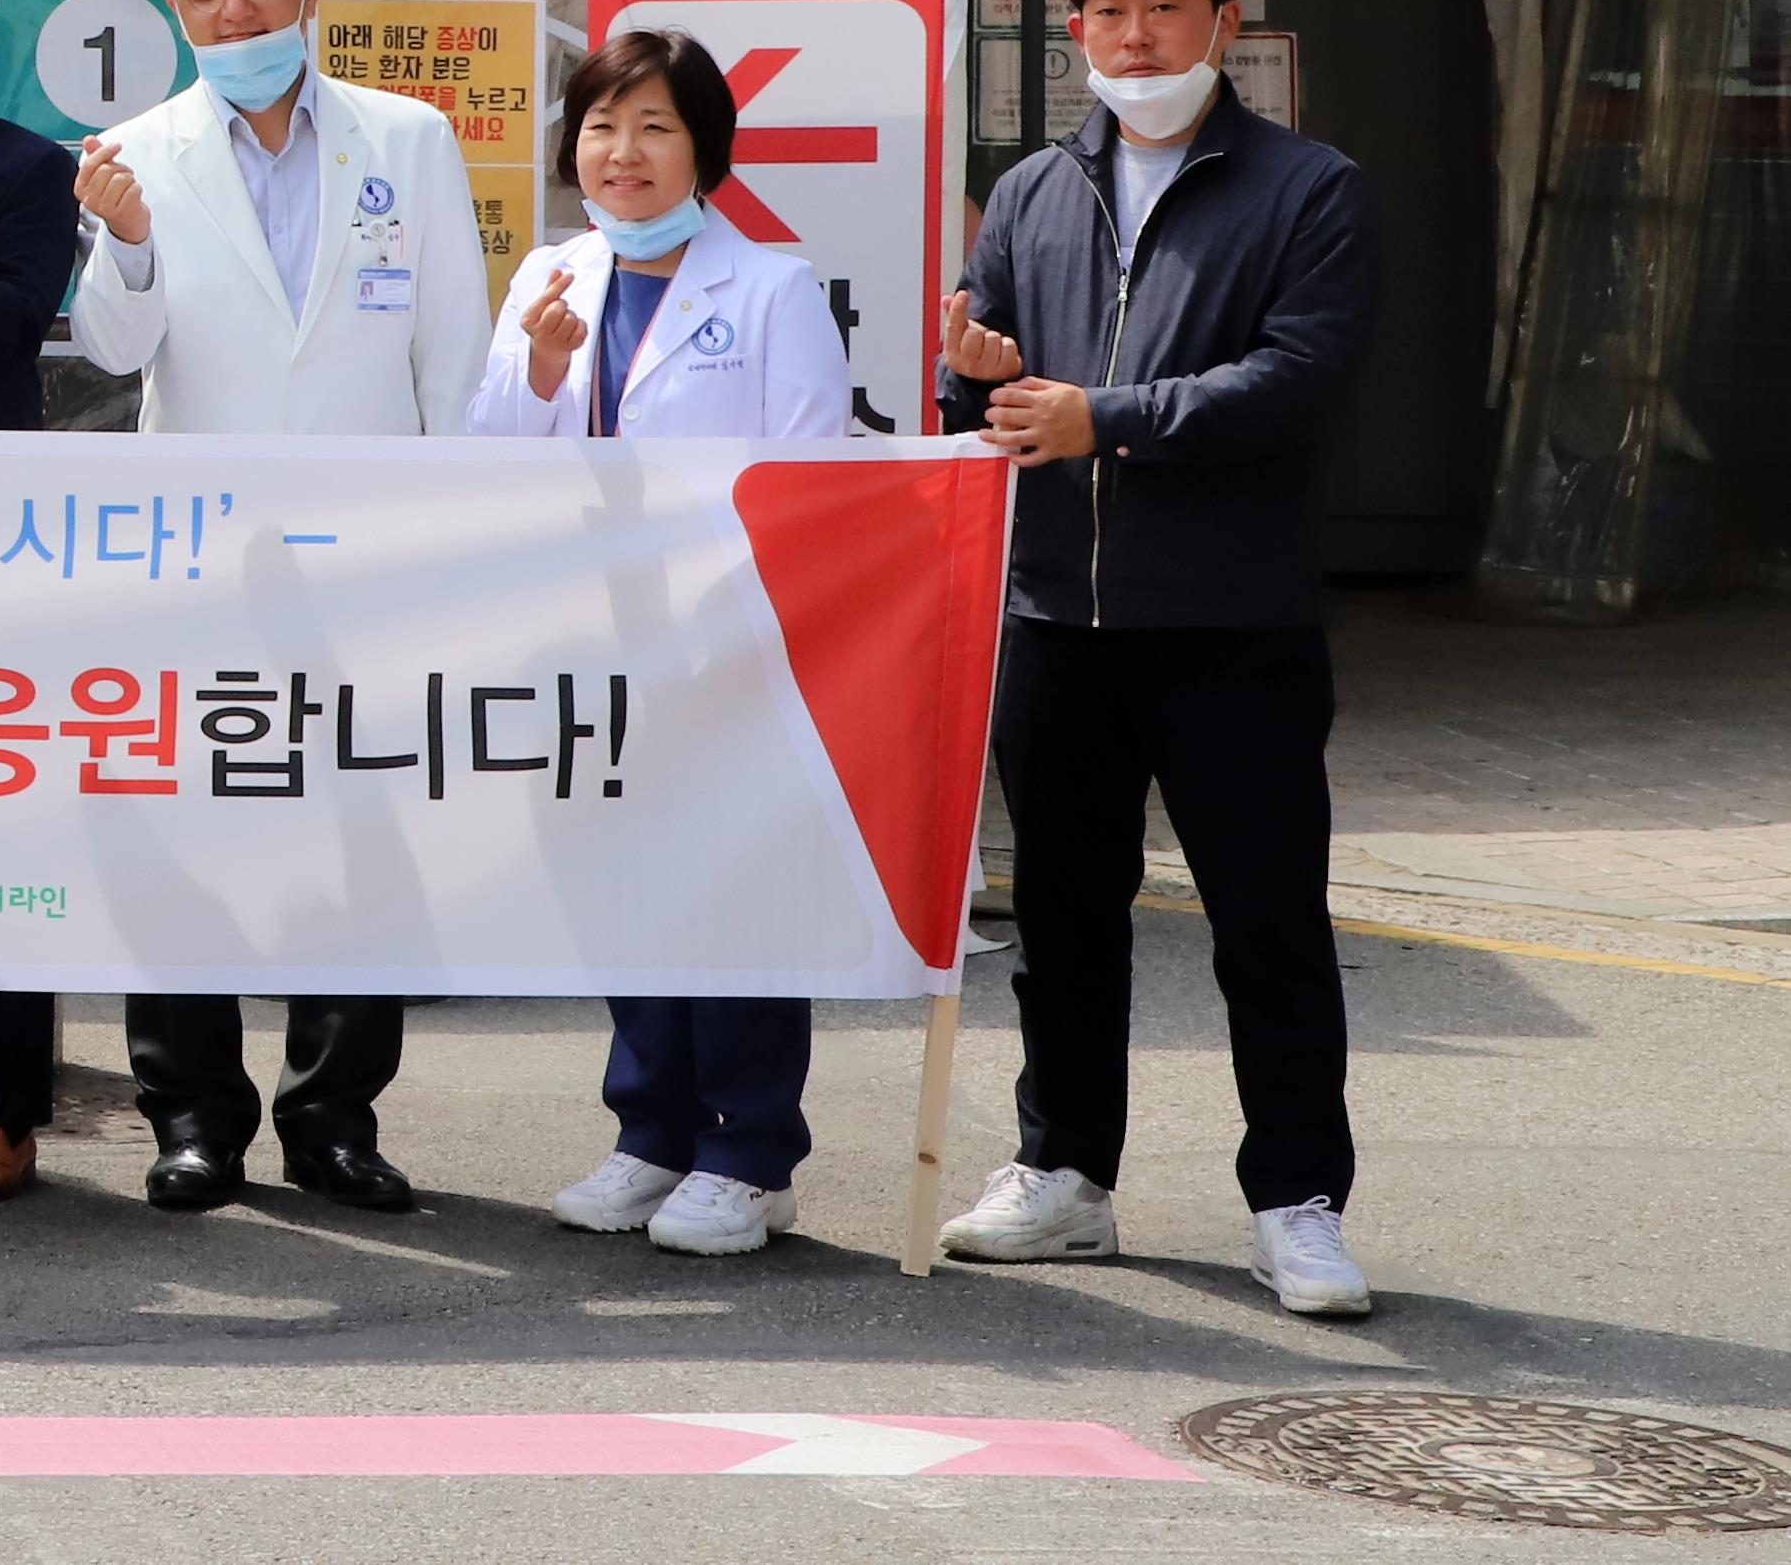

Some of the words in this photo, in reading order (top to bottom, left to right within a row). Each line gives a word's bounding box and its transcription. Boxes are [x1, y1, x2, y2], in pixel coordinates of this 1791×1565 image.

[328, 24, 373, 50] 아래
[382, 25, 428, 50] 해당
[436, 26, 498, 52] 증상이
[83, 26, 115, 102] 1
[329, 54, 368, 78] 있는
[379, 55, 423, 80] 환자
[432, 58, 471, 81] 분은
[467, 87, 527, 112] 누르고
